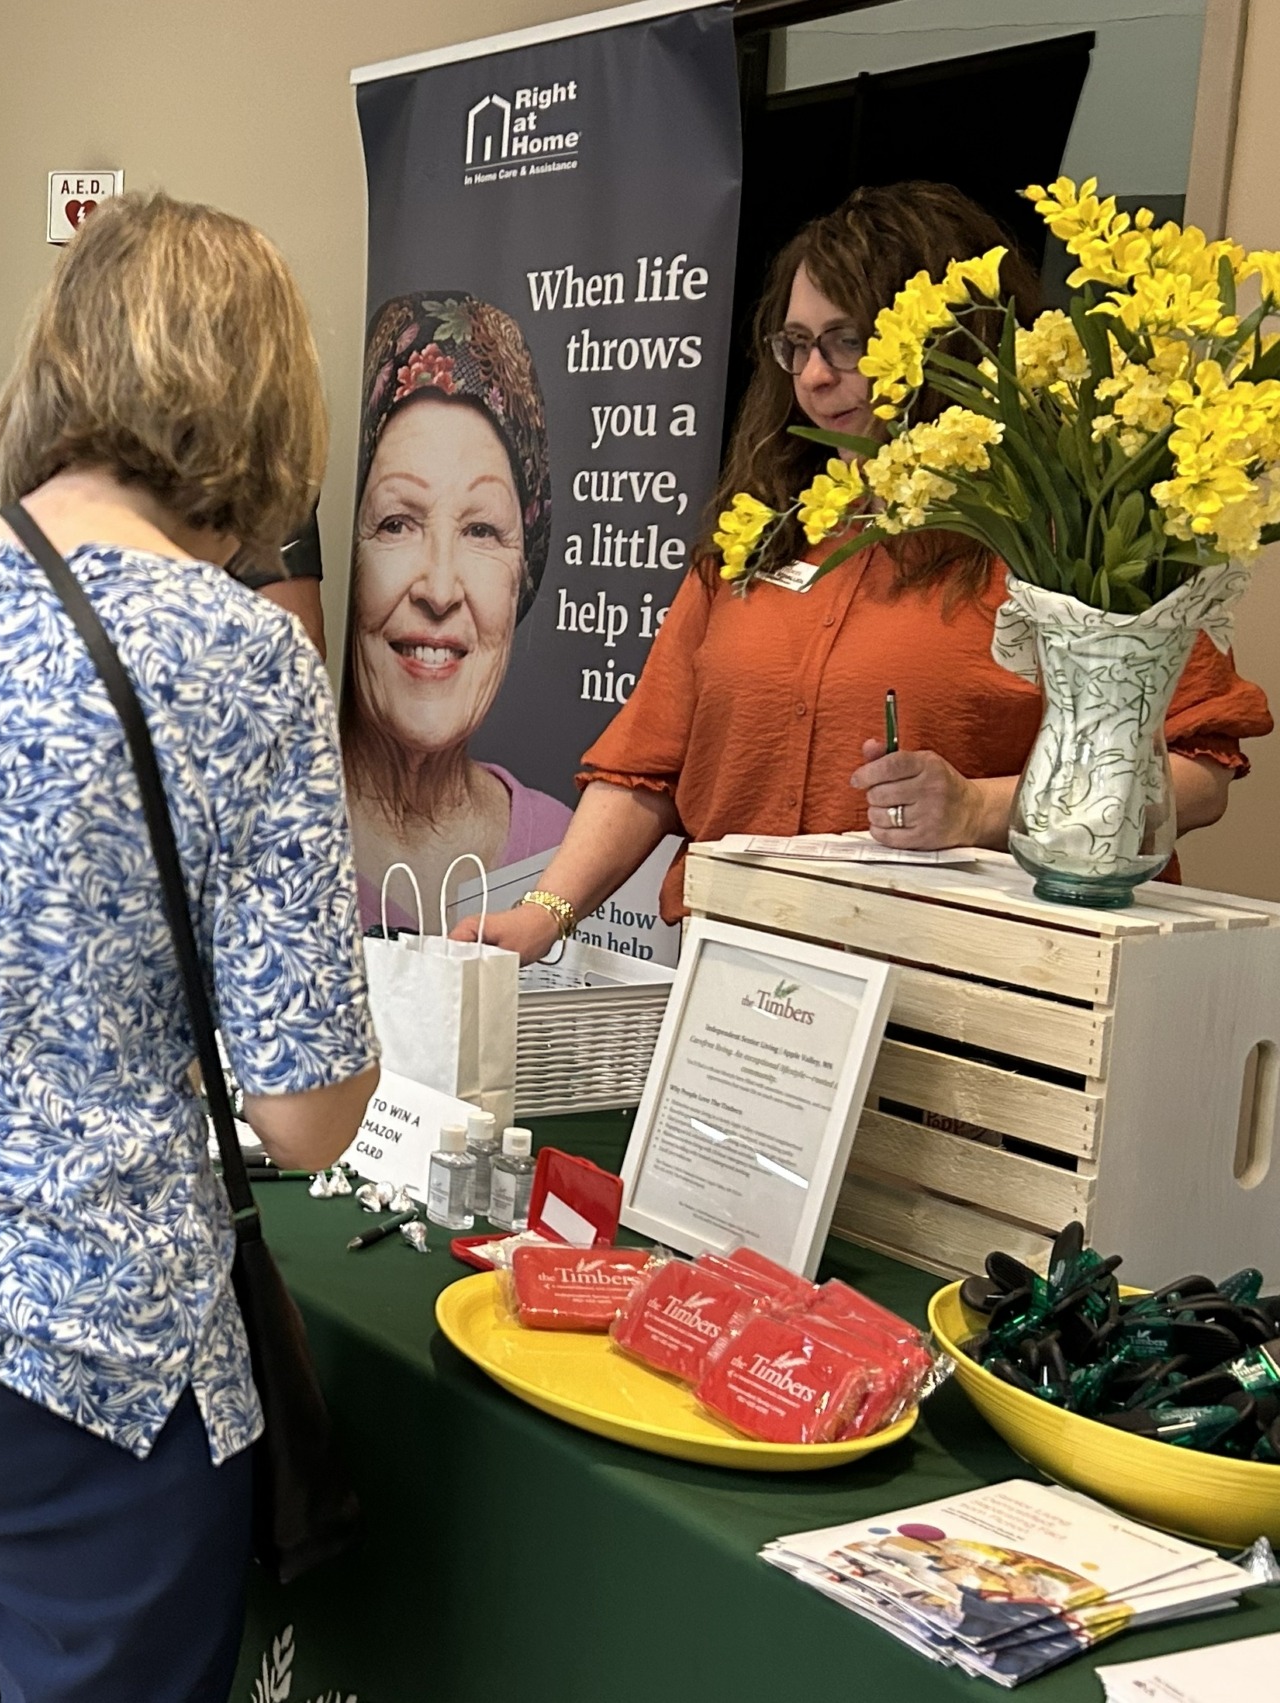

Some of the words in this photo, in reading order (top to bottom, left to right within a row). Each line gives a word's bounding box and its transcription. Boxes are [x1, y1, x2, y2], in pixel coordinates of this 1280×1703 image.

[515, 81, 577, 109] Right
[513, 112, 537, 133] at
[512, 131, 579, 156] Home
[61, 180, 105, 195] A.E.D.
[464, 175, 473, 185] In
[474, 173, 497, 184] Home
[498, 168, 518, 180] Care
[520, 166, 526, 176] &
[529, 160, 578, 175] Assistance
[527, 265, 624, 311] When
[634, 254, 709, 302] life
[566, 328, 702, 373] throws
[591, 403, 657, 449] you
[669, 402, 697, 436] a
[572, 470, 688, 515] curve,
[564, 533, 583, 565] a
[590, 523, 686, 570] little
[556, 589, 629, 647] help
[580, 659, 636, 704] nic
[609, 902, 657, 930] how
[607, 932, 654, 960] help
[741, 994, 754, 1007] the
[757, 989, 815, 1025] Timbers
[373, 1098, 387, 1112] TO
[389, 1105, 412, 1123] WIN
[411, 1115, 420, 1128] A
[362, 1119, 402, 1143] MAZON
[356, 1141, 383, 1160] CARD
[538, 1272, 556, 1281] the
[554, 1267, 641, 1286] Timbers
[662, 1295, 722, 1338] Timbers
[747, 1353, 816, 1402] Timbers
